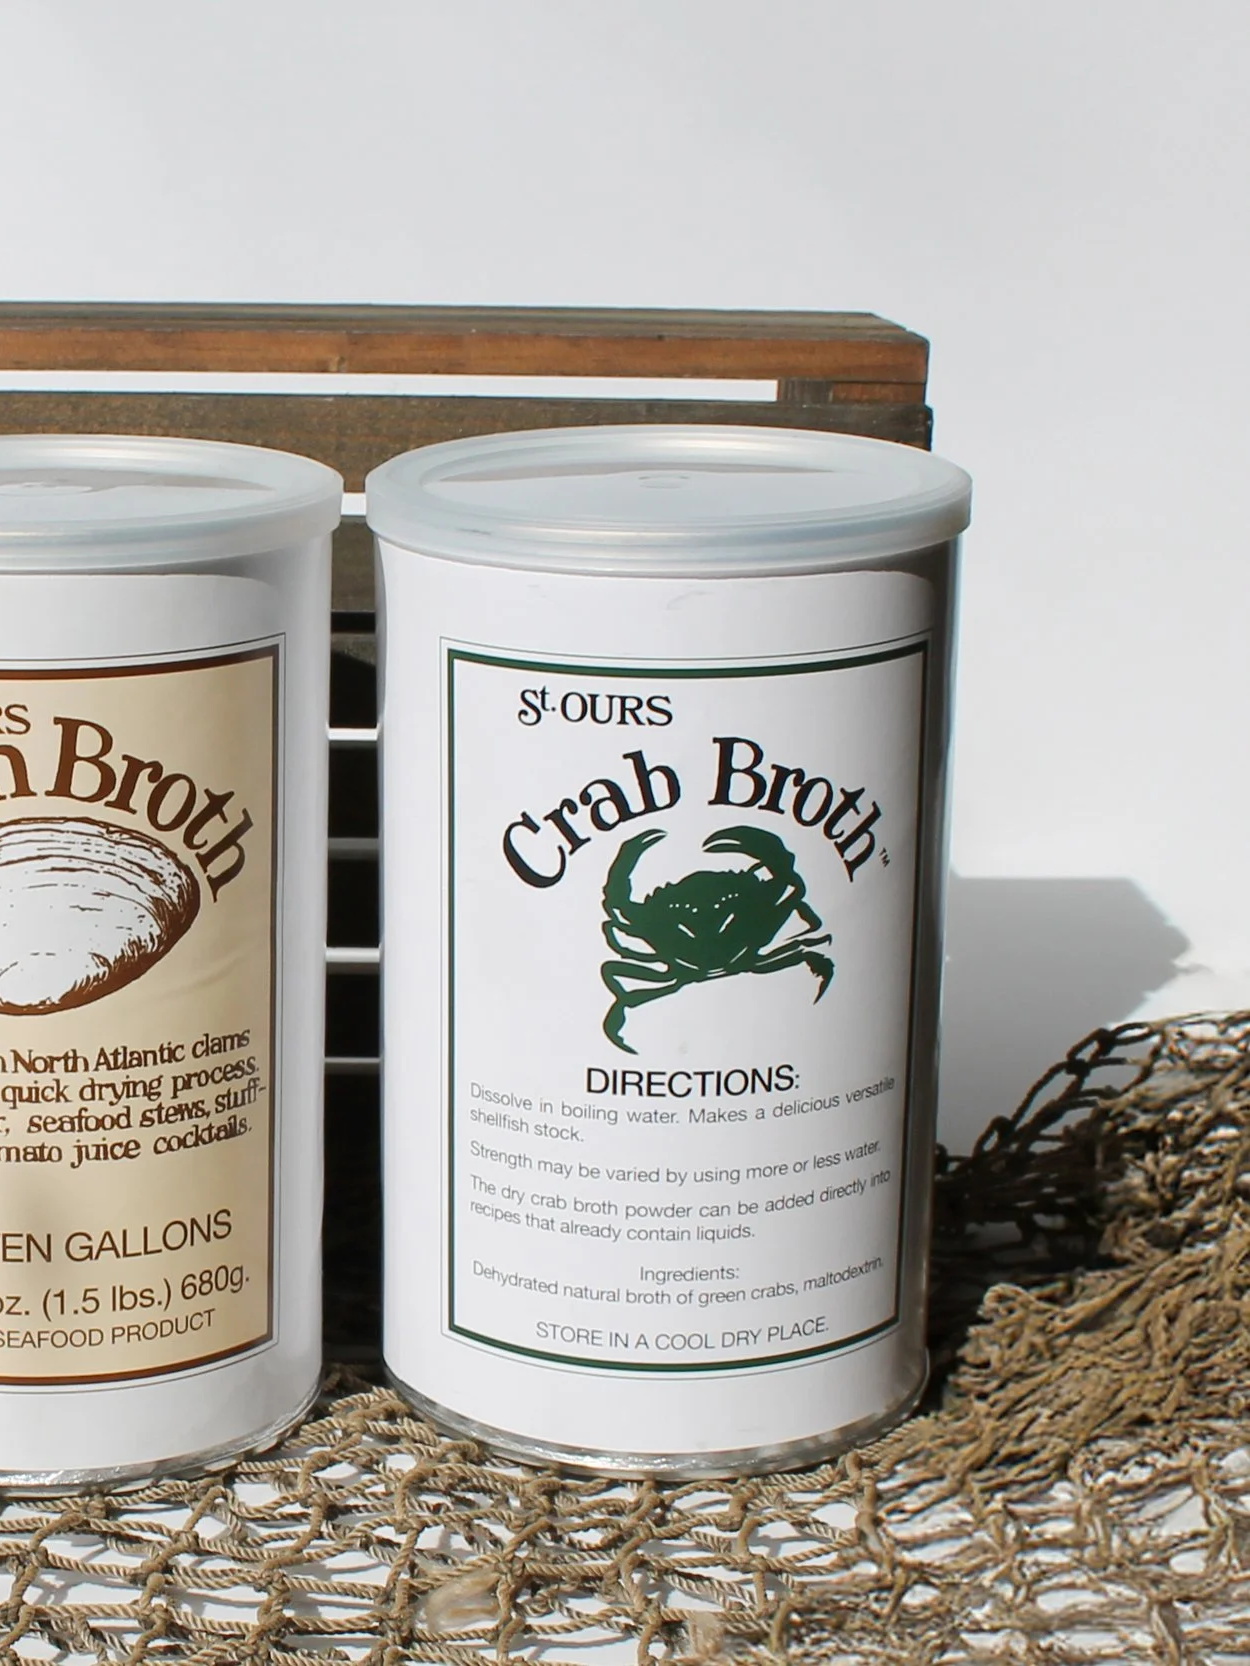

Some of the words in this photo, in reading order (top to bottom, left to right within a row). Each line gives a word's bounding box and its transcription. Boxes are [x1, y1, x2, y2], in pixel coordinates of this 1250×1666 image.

[560, 691, 673, 726] OURS
[45, 717, 254, 903] Broth
[502, 750, 681, 888] Crab
[708, 736, 883, 883] Broth
[11, 1049, 89, 1073] North
[95, 1041, 184, 1072] Atlantic
[191, 1029, 250, 1058] clams
[1, 1079, 69, 1110] quick
[78, 1076, 161, 1102] drying
[171, 1055, 259, 1098] process.
[471, 1082, 532, 1112] Dissolve
[539, 1098, 553, 1113] in
[561, 1101, 618, 1125] boiling
[626, 1107, 679, 1124] water.
[689, 1106, 748, 1124] Makes
[755, 1107, 766, 1121] a
[772, 1092, 840, 1119] delicious
[845, 1076, 895, 1104] versatile
[585, 1064, 800, 1098] DIRECTIONS:
[26, 1105, 132, 1133] seafood
[139, 1095, 210, 1127] stews,
[470, 1107, 529, 1134] shellfish
[534, 1123, 584, 1143] stock.
[70, 1137, 141, 1168] juice
[153, 1115, 252, 1156] cocktails.
[471, 1140, 532, 1171] Strength
[538, 1160, 572, 1179] may
[578, 1161, 601, 1179] be
[606, 1165, 660, 1184] varied
[666, 1168, 687, 1187] by
[693, 1165, 741, 1185] using
[746, 1159, 788, 1180] more
[793, 1158, 809, 1174] or
[813, 1151, 841, 1170] less
[844, 1138, 881, 1162] water.
[471, 1175, 496, 1196] The
[501, 1183, 525, 1206] dry
[531, 1190, 567, 1210] crab
[574, 1196, 618, 1216] broth
[625, 1202, 692, 1220] powder
[699, 1202, 730, 1217] can
[737, 1197, 759, 1215] be
[765, 1191, 815, 1213] added
[820, 1178, 866, 1204] directly
[871, 1168, 891, 1187] into
[64, 1209, 232, 1262] GALLONS
[470, 1200, 521, 1228] recipes
[526, 1212, 555, 1231] that
[560, 1219, 621, 1243] already
[626, 1223, 691, 1242] contain
[696, 1222, 755, 1244] liquids.
[43, 1289, 100, 1322] (1.5
[111, 1279, 171, 1312] lbs.)
[180, 1264, 250, 1301] 680g.
[473, 1260, 558, 1295] Dehydrated
[564, 1283, 620, 1302] natural
[626, 1286, 670, 1304] broth
[676, 1287, 694, 1304] of
[698, 1286, 746, 1308] green
[751, 1278, 798, 1299] crabs,
[640, 1266, 740, 1285] Ingredients:
[111, 1308, 216, 1344] PRODUCT
[536, 1322, 602, 1346] STORE
[610, 1330, 628, 1348] IN
[634, 1332, 650, 1349] A
[655, 1332, 715, 1351] COOL
[721, 1328, 762, 1347] DRY
[767, 1316, 829, 1341] PLACE.
